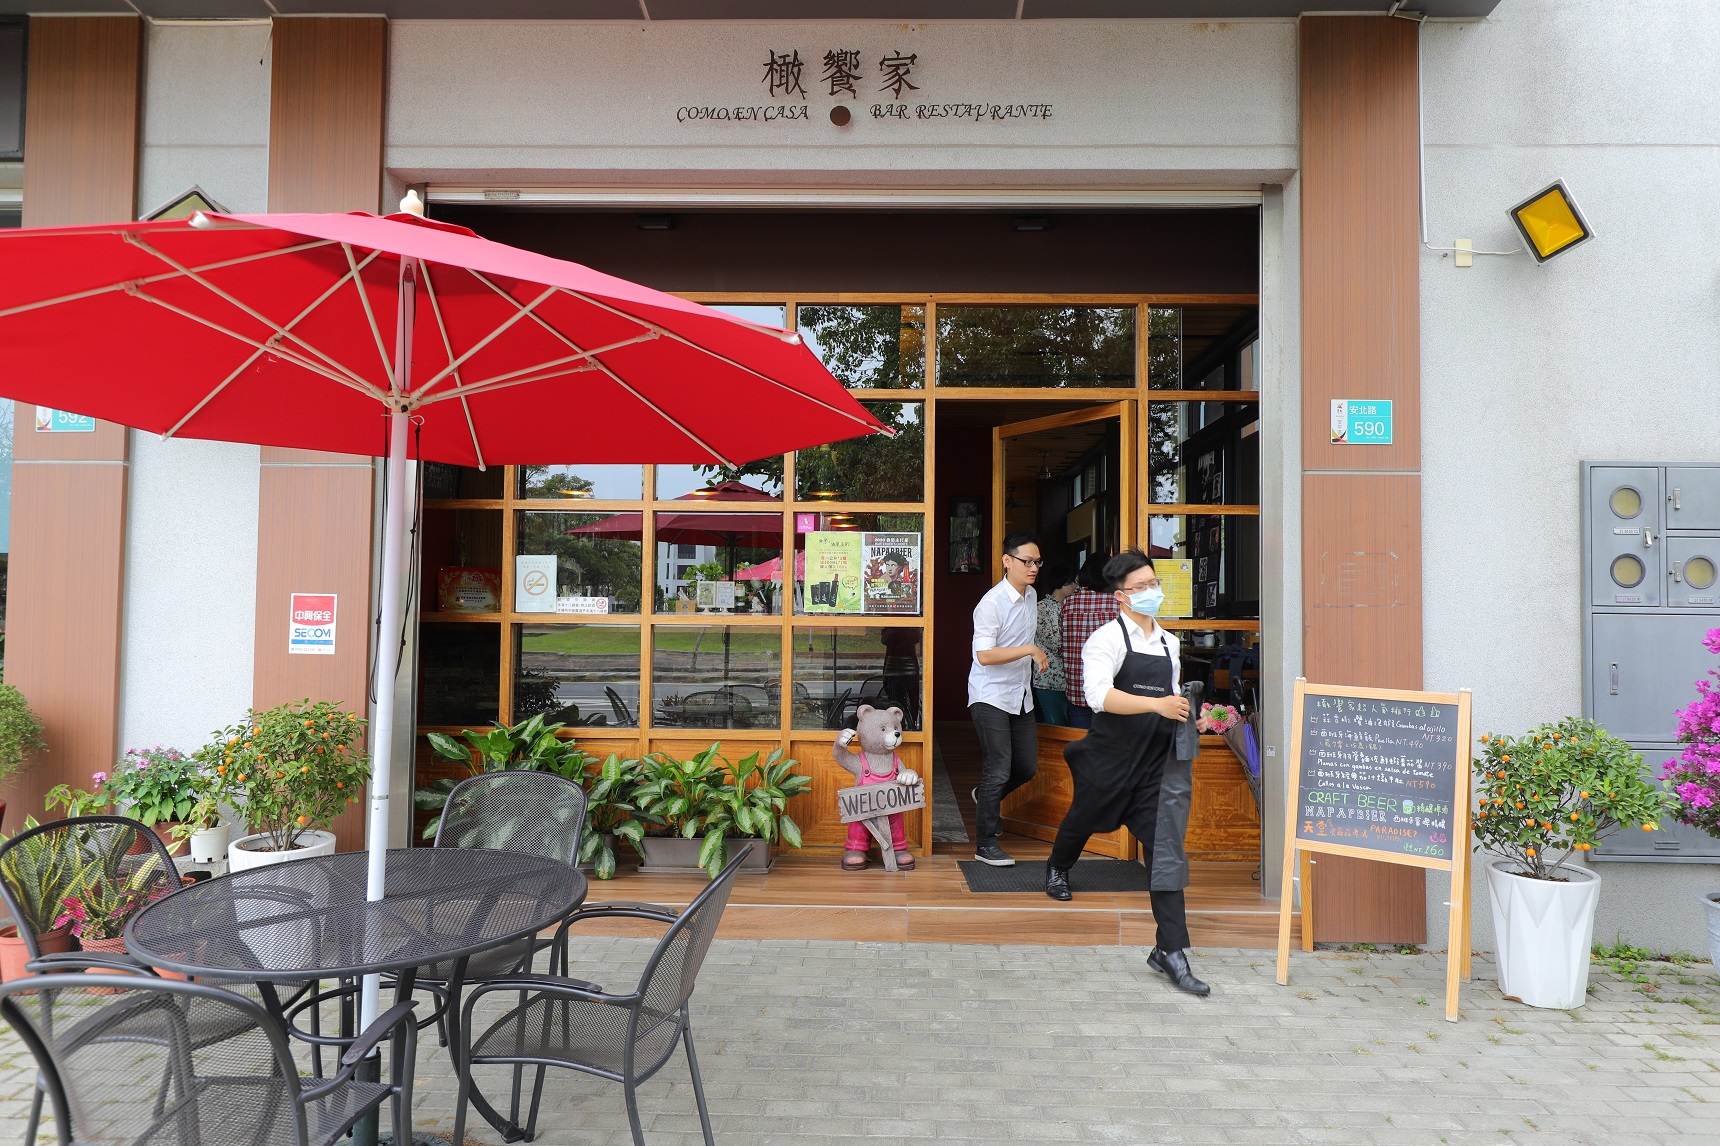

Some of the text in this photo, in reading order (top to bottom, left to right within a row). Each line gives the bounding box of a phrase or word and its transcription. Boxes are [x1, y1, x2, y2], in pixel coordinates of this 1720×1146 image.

[761, 48, 921, 100] 橄饗家
[676, 103, 1053, 123] COMO EN CASA BAR RESTAURANTE
[1349, 405, 1377, 415] 安北路
[1354, 421, 1385, 436] 590
[294, 609, 332, 622] 中興保全
[294, 627, 331, 638] SECOM
[841, 784, 921, 817] WELCOME
[1307, 791, 1350, 805] CRAFT
[1357, 793, 1397, 813] BEER
